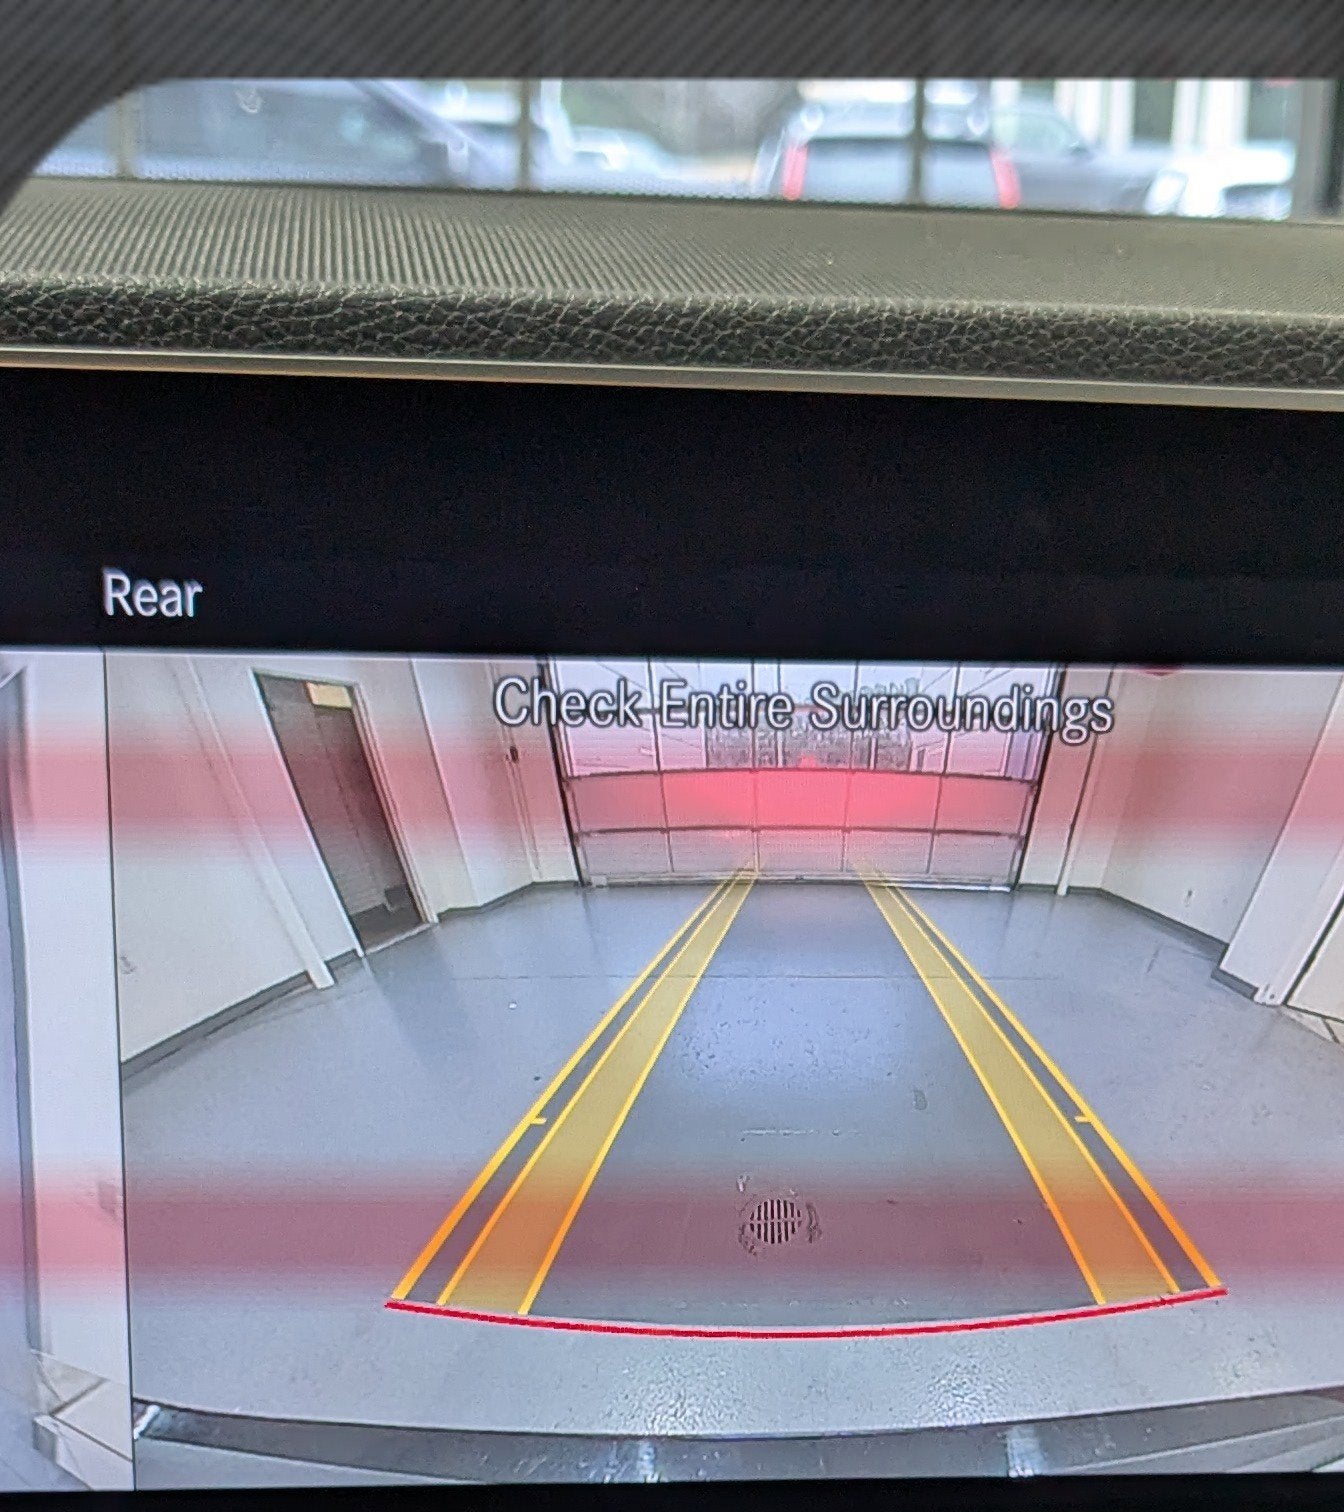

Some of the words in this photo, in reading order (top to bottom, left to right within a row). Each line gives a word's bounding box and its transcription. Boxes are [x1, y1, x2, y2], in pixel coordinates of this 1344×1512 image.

[102, 567, 204, 618] Rear
[494, 675, 644, 728] Check
[657, 678, 797, 730] Entire
[809, 680, 1115, 746] Surroundings
